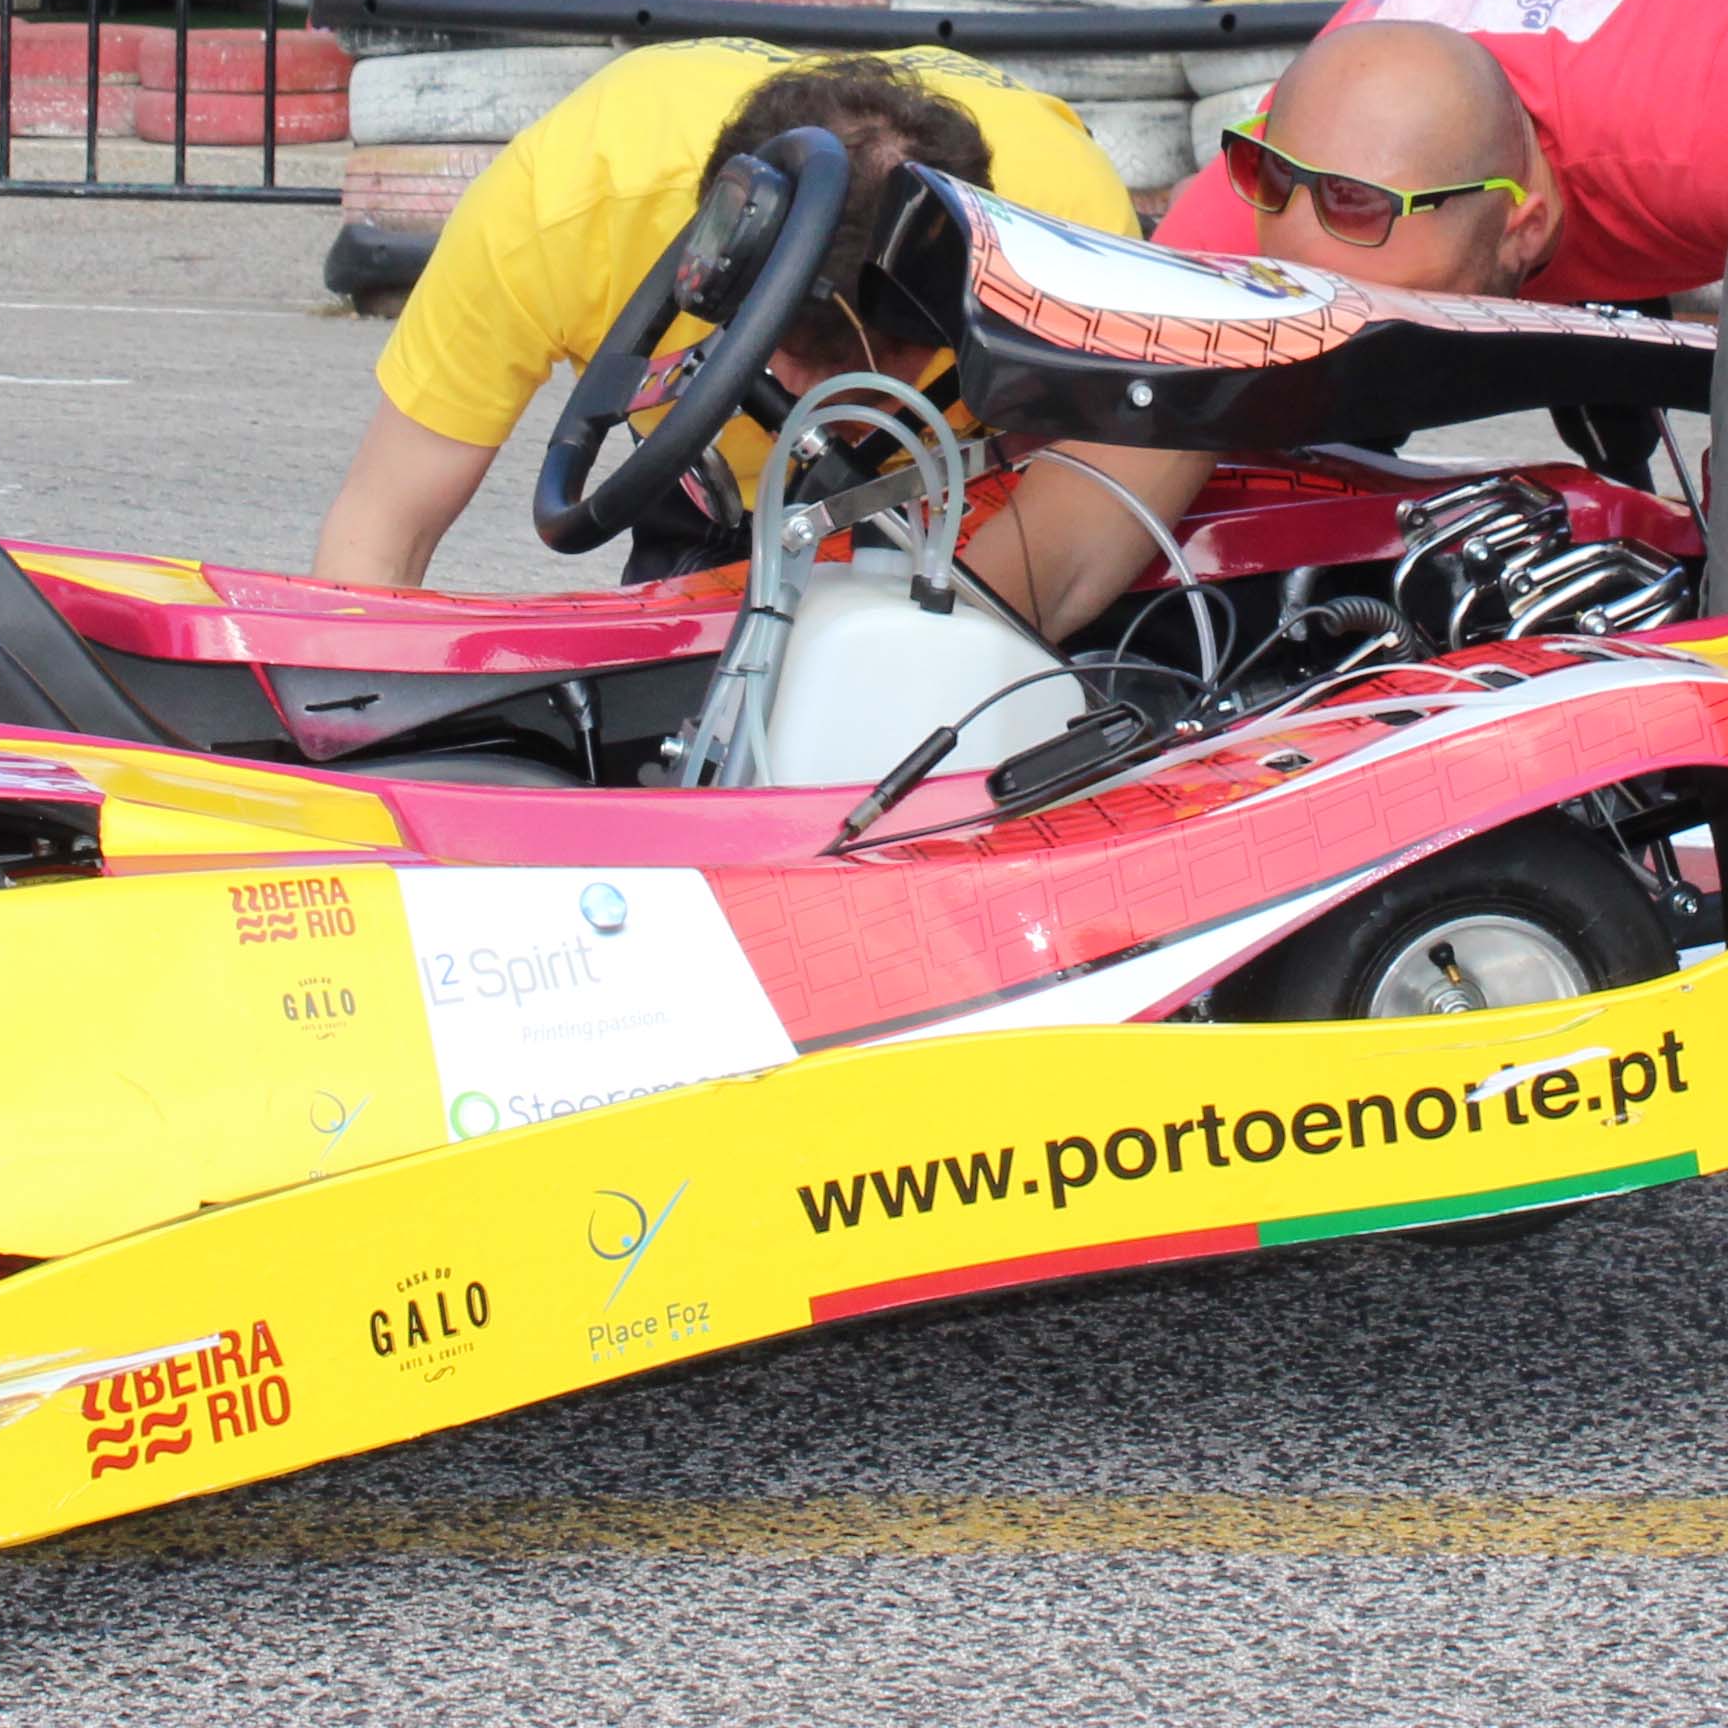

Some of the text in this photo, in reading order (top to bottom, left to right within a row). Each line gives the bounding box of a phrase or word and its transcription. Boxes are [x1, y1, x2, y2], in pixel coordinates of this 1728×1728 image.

[262, 878, 349, 913] BEIRA
[307, 907, 356, 940] RIO
[468, 936, 601, 1007] Spirit
[283, 987, 356, 1021] GALO
[798, 1031, 1689, 1234] www.portoenorte.pt
[396, 1267, 452, 1293] CASA DO
[370, 1281, 489, 1357] GALO
[588, 1302, 710, 1351] Place Foz
[133, 1320, 284, 1408] BEIRA
[208, 1374, 291, 1443] RIO
